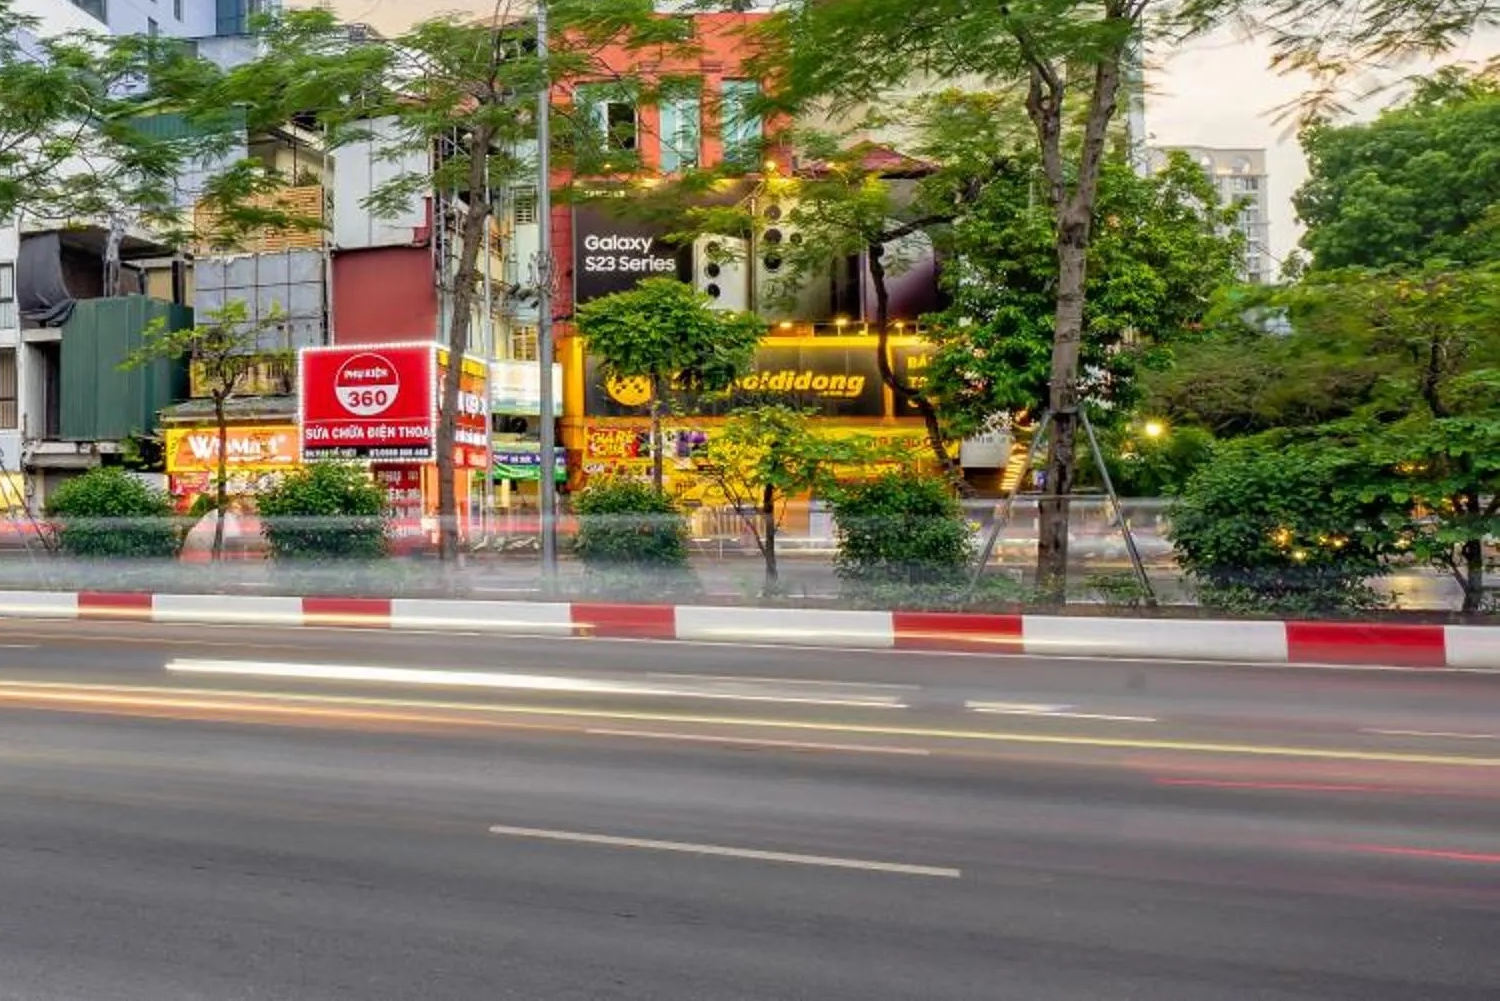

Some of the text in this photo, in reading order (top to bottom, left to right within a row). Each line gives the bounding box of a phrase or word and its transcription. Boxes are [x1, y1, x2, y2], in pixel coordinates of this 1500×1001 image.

[584, 234, 653, 254] Galaxy
[585, 255, 676, 272] S23 Series
[348, 390, 388, 408] 360
[398, 426, 433, 440] THOẠ
